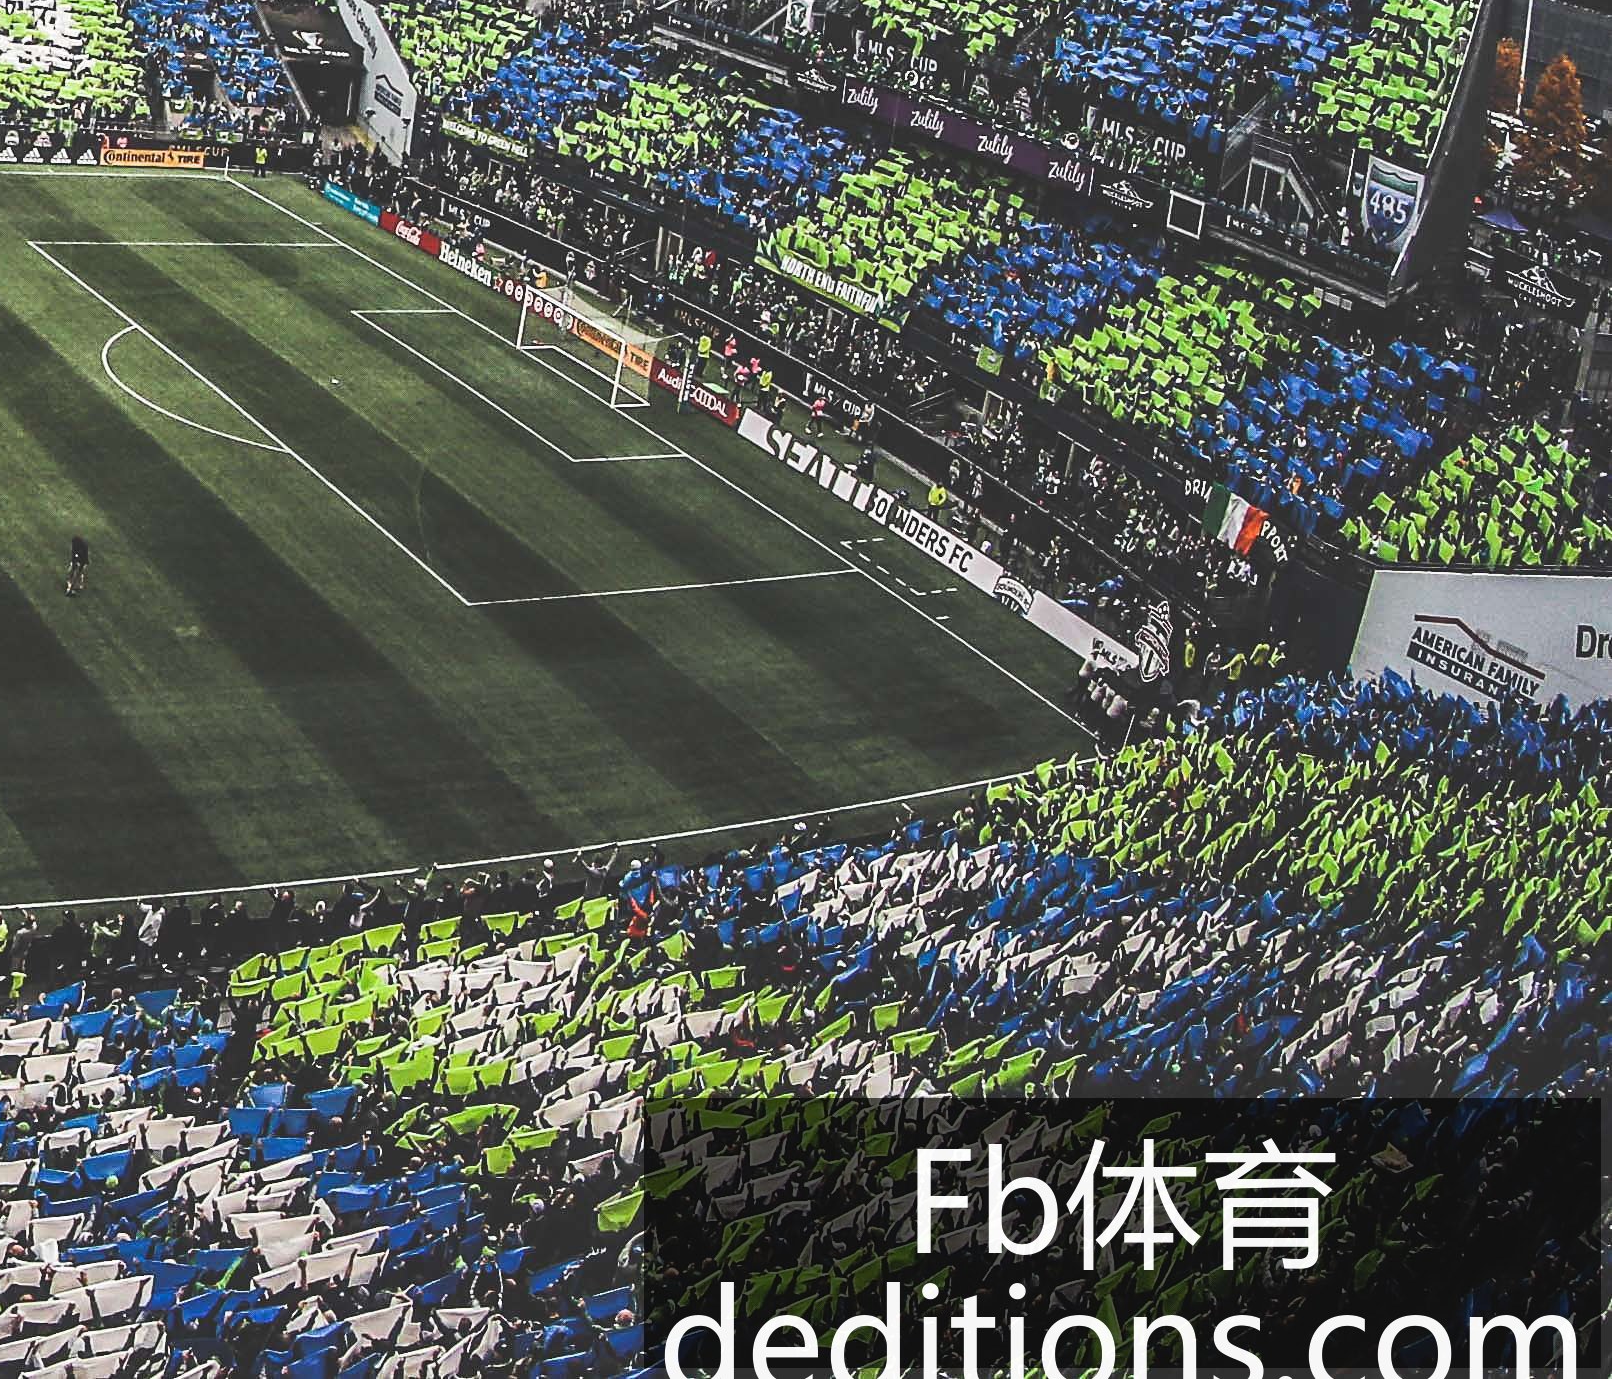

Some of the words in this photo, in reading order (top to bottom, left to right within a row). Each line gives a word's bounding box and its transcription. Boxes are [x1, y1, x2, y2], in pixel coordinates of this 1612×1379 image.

[477, 130, 488, 144] TO
[1101, 117, 1134, 145] MLS
[103, 149, 165, 164] Continental
[177, 155, 201, 165] TIRE
[1368, 189, 1410, 225] 485
[439, 241, 492, 287] Heineken
[779, 254, 813, 284] NORTH
[1507, 277, 1563, 308] MUCKLESHOOT
[657, 368, 683, 391] Audi
[842, 398, 862, 417] CUP
[948, 540, 974, 573] FC
[1260, 520, 1289, 563] PPORT
[1411, 625, 1485, 673] AMERICAN
[1487, 660, 1541, 698] FAMILY
[1415, 647, 1504, 699] INSURAN
